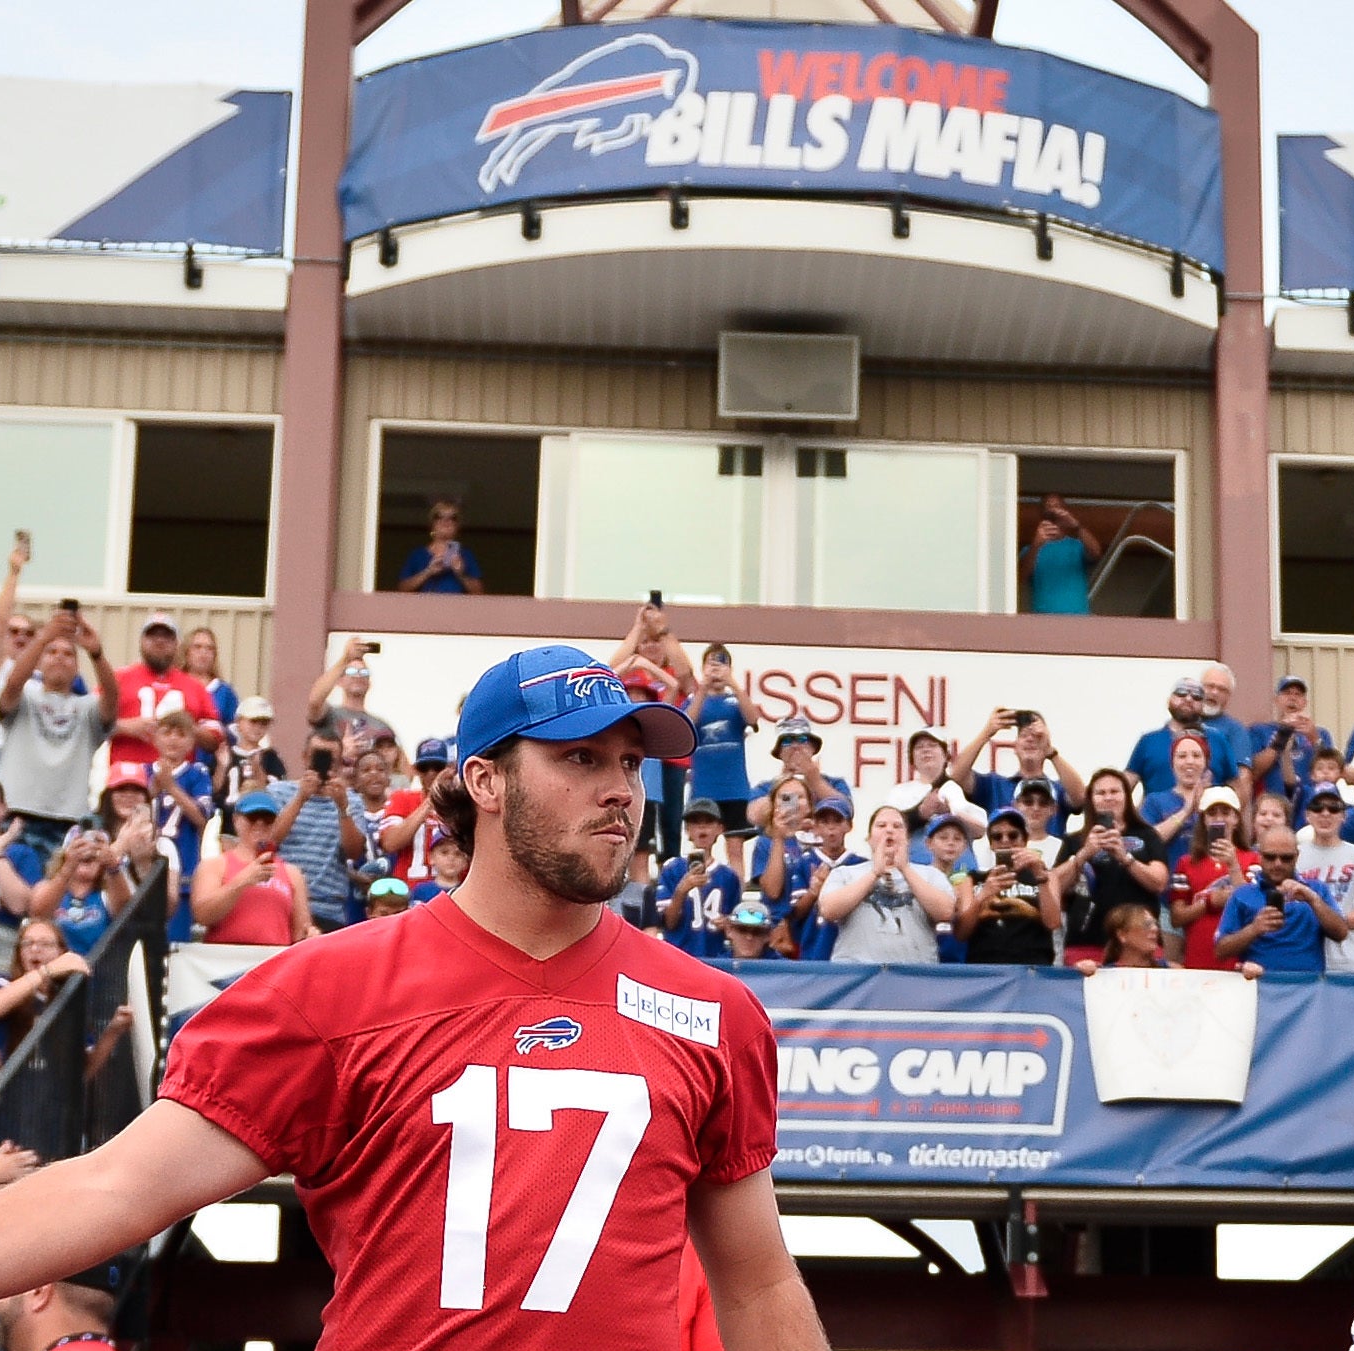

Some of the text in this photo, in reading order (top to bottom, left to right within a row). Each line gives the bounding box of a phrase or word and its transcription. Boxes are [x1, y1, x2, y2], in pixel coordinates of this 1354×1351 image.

[757, 50, 1010, 114] WELCOME
[645, 90, 1105, 209] BILLS MAFIA!
[688, 886, 723, 931] 14
[623, 991, 712, 1032] LECOM
[888, 1049, 1047, 1097] CAMP
[908, 1143, 1053, 1170] ticketmaster
[430, 1063, 653, 1315] 17
